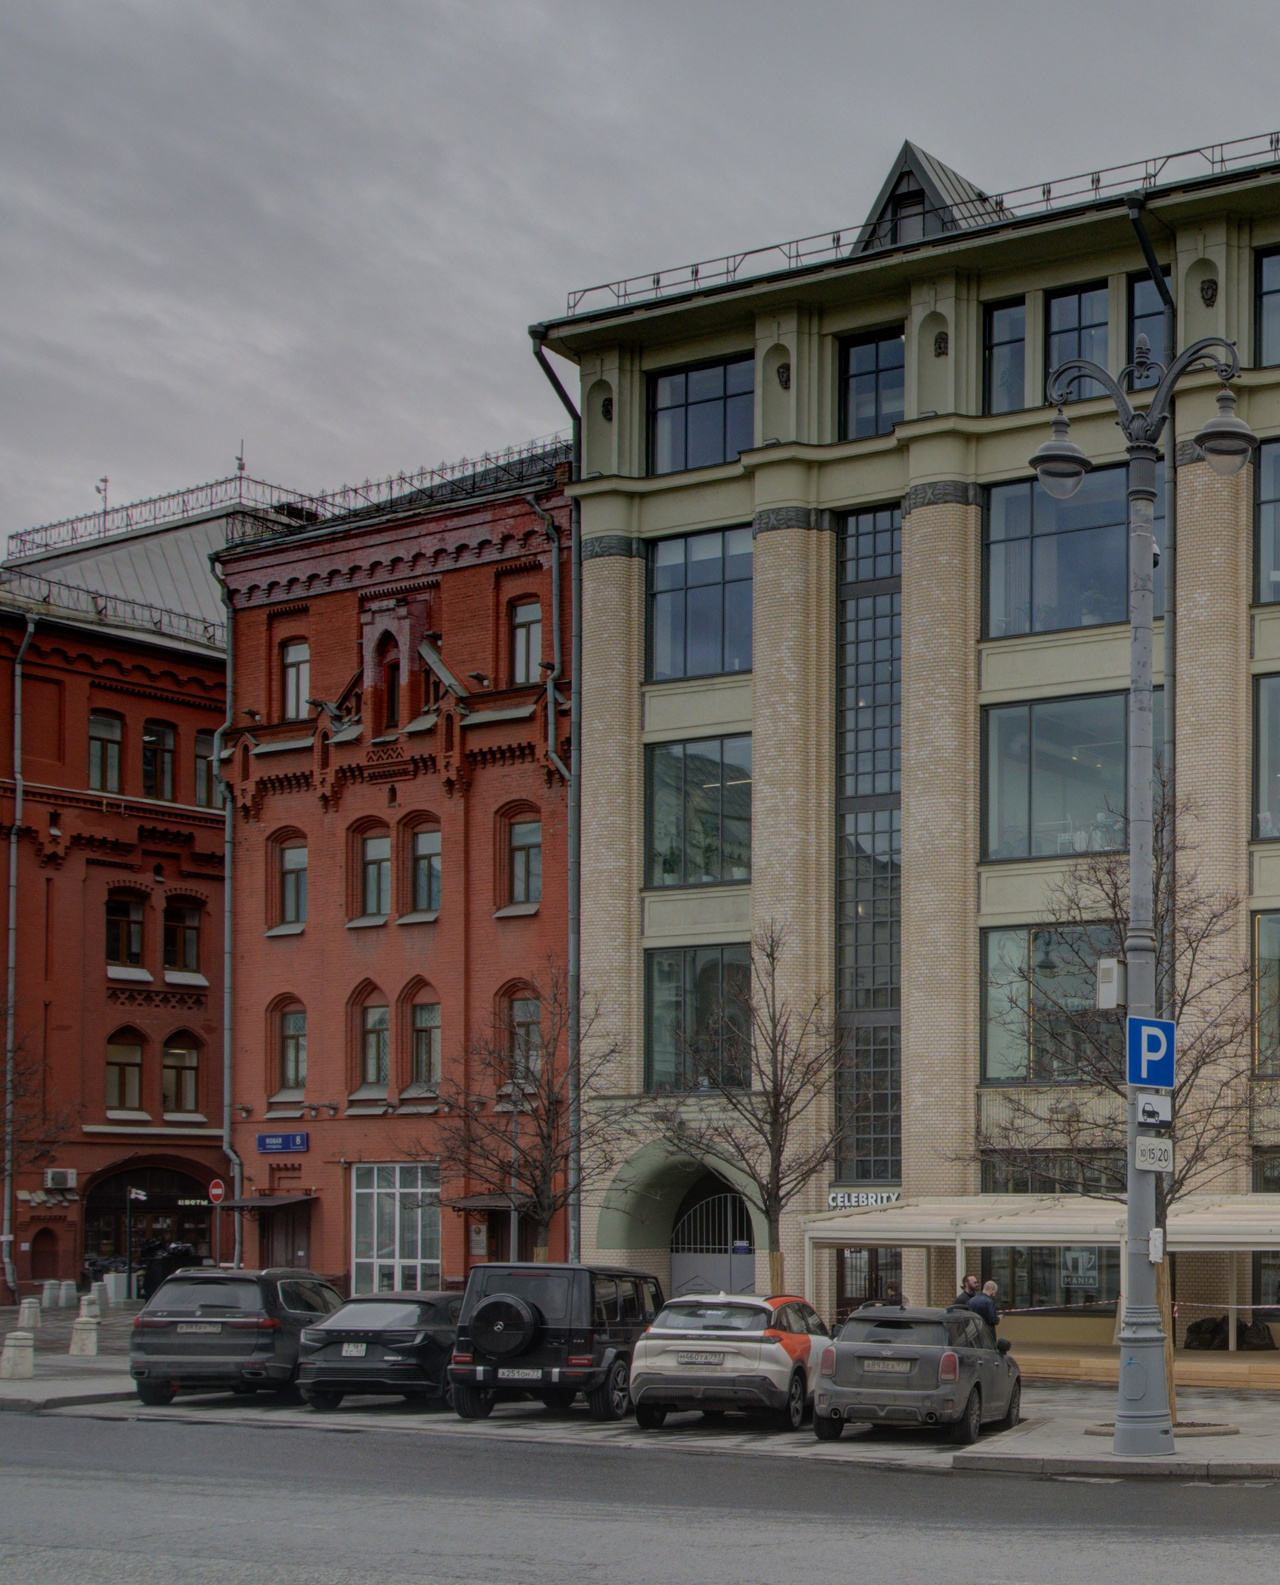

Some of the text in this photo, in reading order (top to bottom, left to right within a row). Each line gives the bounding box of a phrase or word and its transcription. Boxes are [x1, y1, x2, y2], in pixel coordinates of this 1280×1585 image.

[1141, 1025, 1167, 1079] P
[295, 1135, 301, 1145] 8
[1140, 1148, 1169, 1162] 10 15 20
[828, 1191, 900, 1207] CELEBRITY
[1064, 1276, 1095, 1285] MANIA
